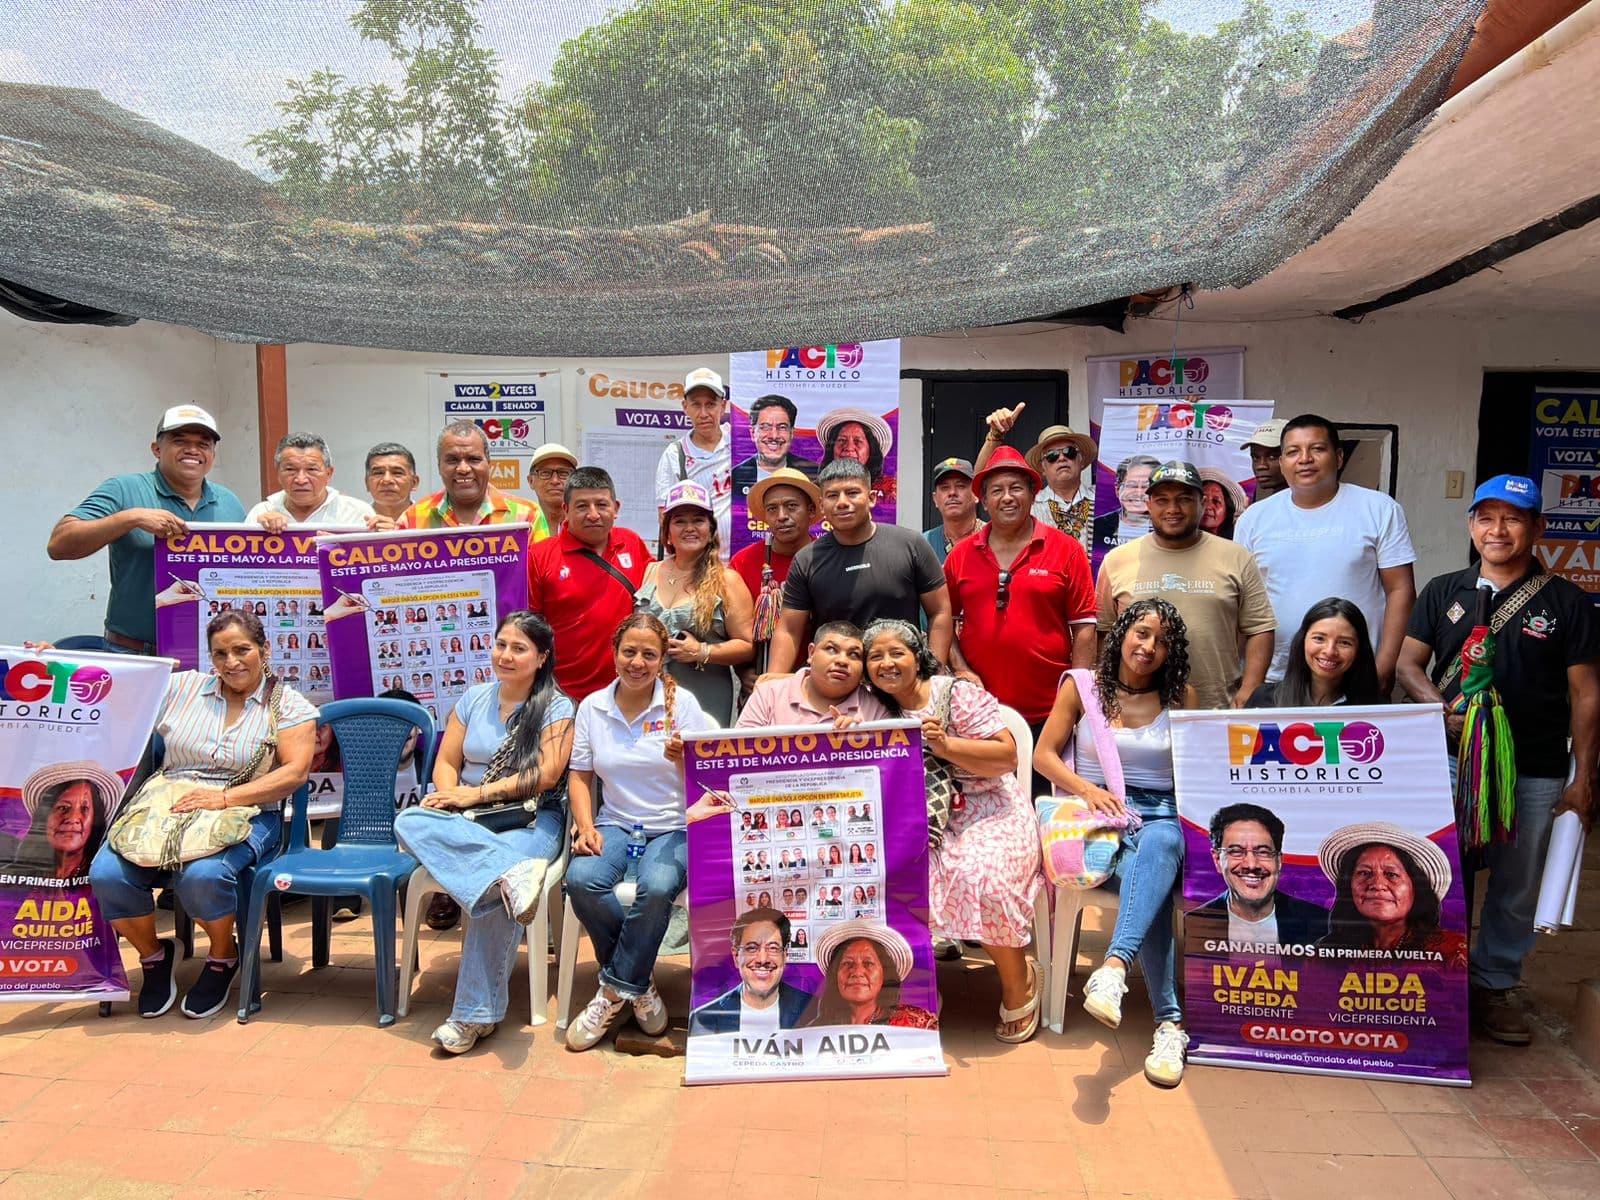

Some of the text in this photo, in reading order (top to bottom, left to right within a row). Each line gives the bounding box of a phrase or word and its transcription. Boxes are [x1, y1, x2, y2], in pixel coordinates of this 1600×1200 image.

[766, 370, 860, 379] HISTORICO
[1119, 358, 1209, 387] PACTO
[459, 382, 534, 399] VOTA 2 VECES
[588, 374, 685, 400] Cauca
[1119, 385, 1207, 396] HISTORICO
[503, 402, 538, 410] SENADO
[626, 413, 661, 425] VOTA
[664, 415, 671, 425] 3
[1137, 404, 1233, 432] PACTO
[1136, 430, 1225, 443] HISTORICO
[1536, 427, 1600, 438] VOTA ESTE
[1555, 451, 1594, 462] VOTA
[167, 535, 285, 554] CALOTO
[328, 543, 439, 567] CALOTO
[444, 535, 520, 556] VOTA
[168, 554, 195, 562] ESTE
[198, 554, 210, 562] 31
[232, 555, 264, 563] MAYO
[331, 554, 519, 577] ESTE 31 DE MAYO A LA PRESIDENCIA
[38, 723, 82, 734] PUEDE
[694, 729, 910, 758] CALOTO VOTA
[1228, 721, 1385, 766] PACTO
[696, 748, 910, 770] ESTE 31 DE MAYO A LA PRESIDENCIA
[1230, 767, 1383, 781] HISTORICO
[1242, 786, 1363, 794] COLOMBIA PUEDE
[0, 875, 15, 884] EN
[18, 876, 70, 888] PRIMERA
[14, 897, 92, 922] AIDA
[12, 918, 93, 938] QUILCUÉ
[1, 936, 101, 950] VICEPRESIDENTA
[1204, 940, 1444, 961] GANAREMOS EN PRIMERA VUELTA
[9, 960, 68, 973] VOTA
[1212, 960, 1298, 992] IVÁN
[1339, 972, 1426, 996] AIDA
[30, 983, 61, 992] pueblo
[1213, 989, 1298, 1009] CEPEDA
[1338, 993, 1427, 1013] QUILCUÉ
[1221, 1005, 1294, 1019] PRESIDENTE
[1328, 1013, 1437, 1027] VICEPRESIDENTA
[733, 1033, 891, 1058] IVÁN AIDA
[1250, 1025, 1399, 1049] CALOTO VOTA
[1265, 1052, 1303, 1062] segundo
[1304, 1055, 1345, 1065] mandato
[1347, 1057, 1361, 1066] del
[1363, 1059, 1394, 1068] pueblo
